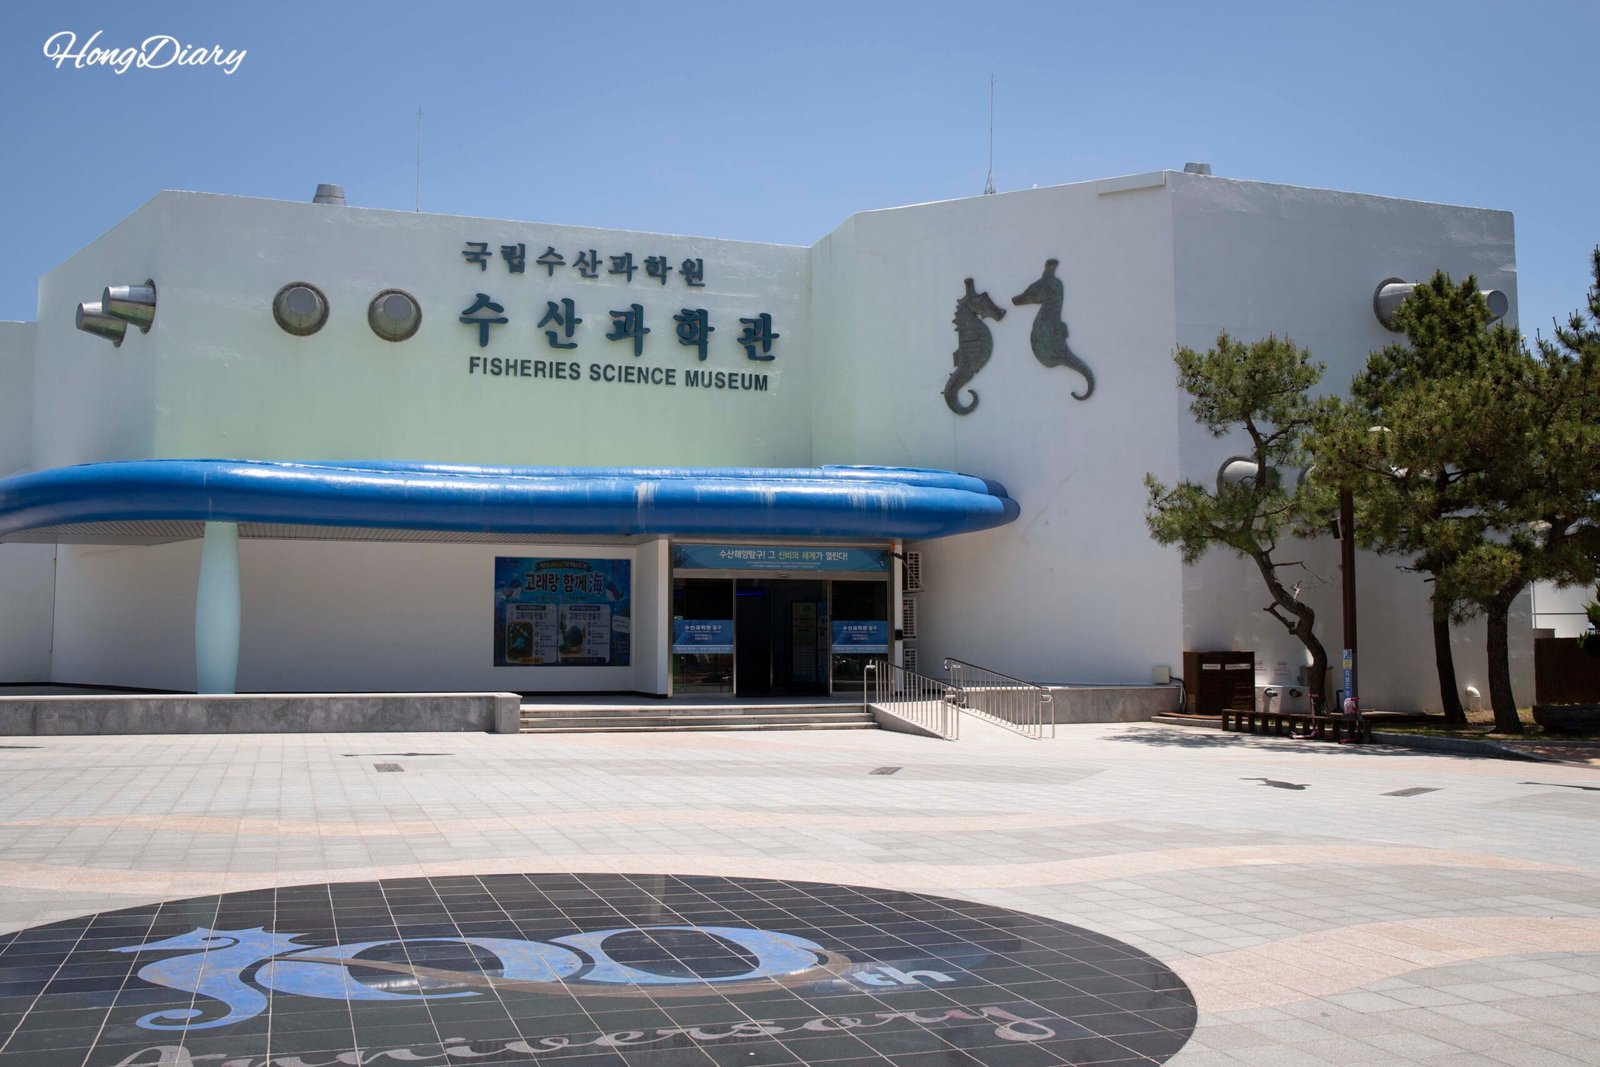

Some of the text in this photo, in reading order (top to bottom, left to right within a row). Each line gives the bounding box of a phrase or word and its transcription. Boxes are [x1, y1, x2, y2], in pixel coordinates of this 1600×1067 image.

[462, 241, 705, 288] 국립수산과학원
[459, 293, 780, 362] 수산과학관
[469, 356, 769, 392] FISHERIES SCIENCE MUSEUM
[768, 550, 776, 560] 그
[778, 551, 800, 560] 신비의
[802, 551, 823, 561] 세계가
[825, 552, 849, 561] 열린다!
[525, 571, 606, 597] 고래랑 함께 海
